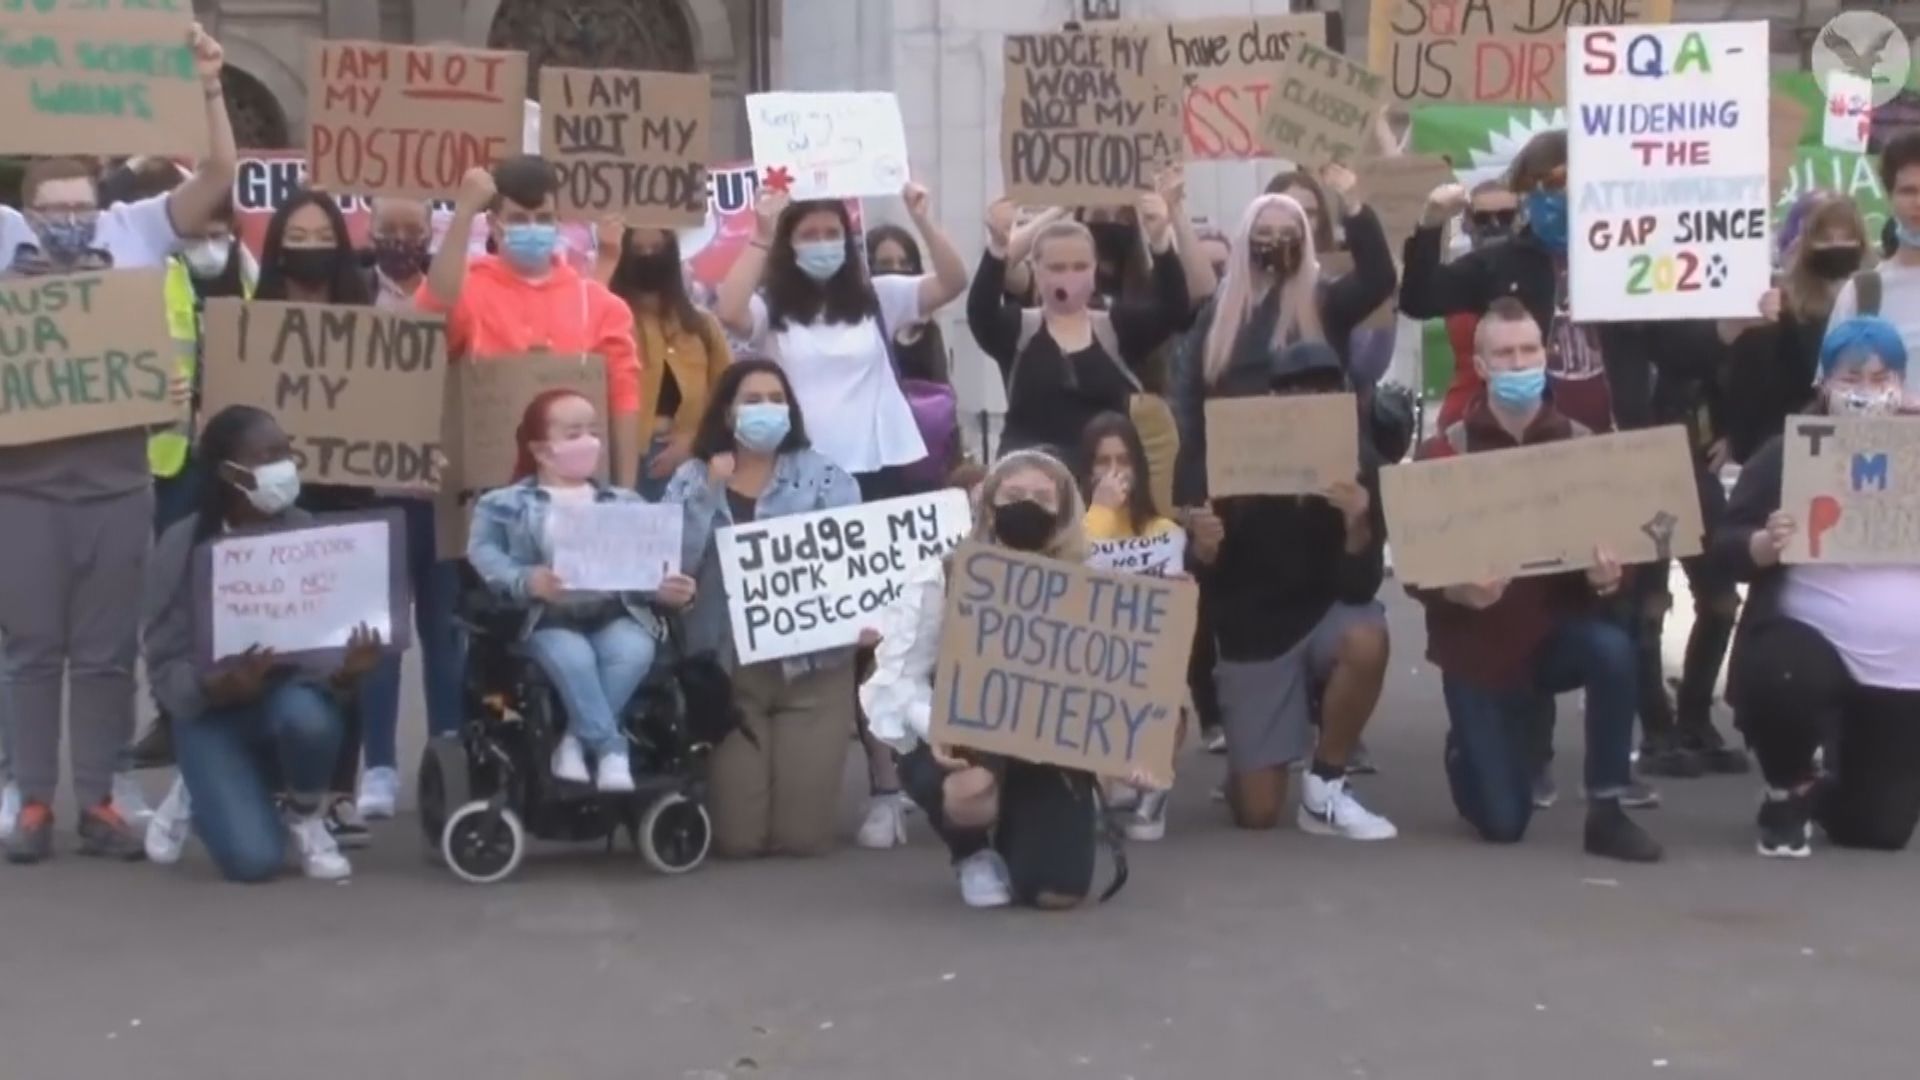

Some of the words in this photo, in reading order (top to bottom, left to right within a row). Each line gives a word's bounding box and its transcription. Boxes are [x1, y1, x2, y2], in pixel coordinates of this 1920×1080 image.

[1006, 34, 1103, 68] JUDGE
[1111, 36, 1149, 77] MY
[1167, 24, 1230, 67] have
[1238, 20, 1308, 66] clas
[337, 46, 388, 81] AM
[405, 52, 505, 92] NOT
[1392, 39, 1457, 99] US
[1475, 40, 1567, 100] DIR
[325, 86, 381, 118] MY
[563, 73, 574, 108] I
[588, 75, 641, 112] AM
[1021, 98, 1086, 129] NOT
[1096, 100, 1144, 126] MY
[553, 113, 628, 156] NOT
[641, 116, 698, 157] MY
[1580, 101, 1740, 136] WIDENING
[1011, 131, 1156, 191] POSTCODE
[1631, 141, 1711, 166] THE
[554, 160, 707, 213] POSTCODE
[1588, 216, 1657, 252] GAP
[1673, 209, 1766, 244] SINCE
[238, 304, 247, 363] I
[271, 307, 357, 370] AM
[366, 315, 447, 373] NOT
[277, 372, 348, 411] MY
[735, 517, 867, 572] Judge
[964, 552, 1069, 614] STOP
[1087, 575, 1171, 634] THE
